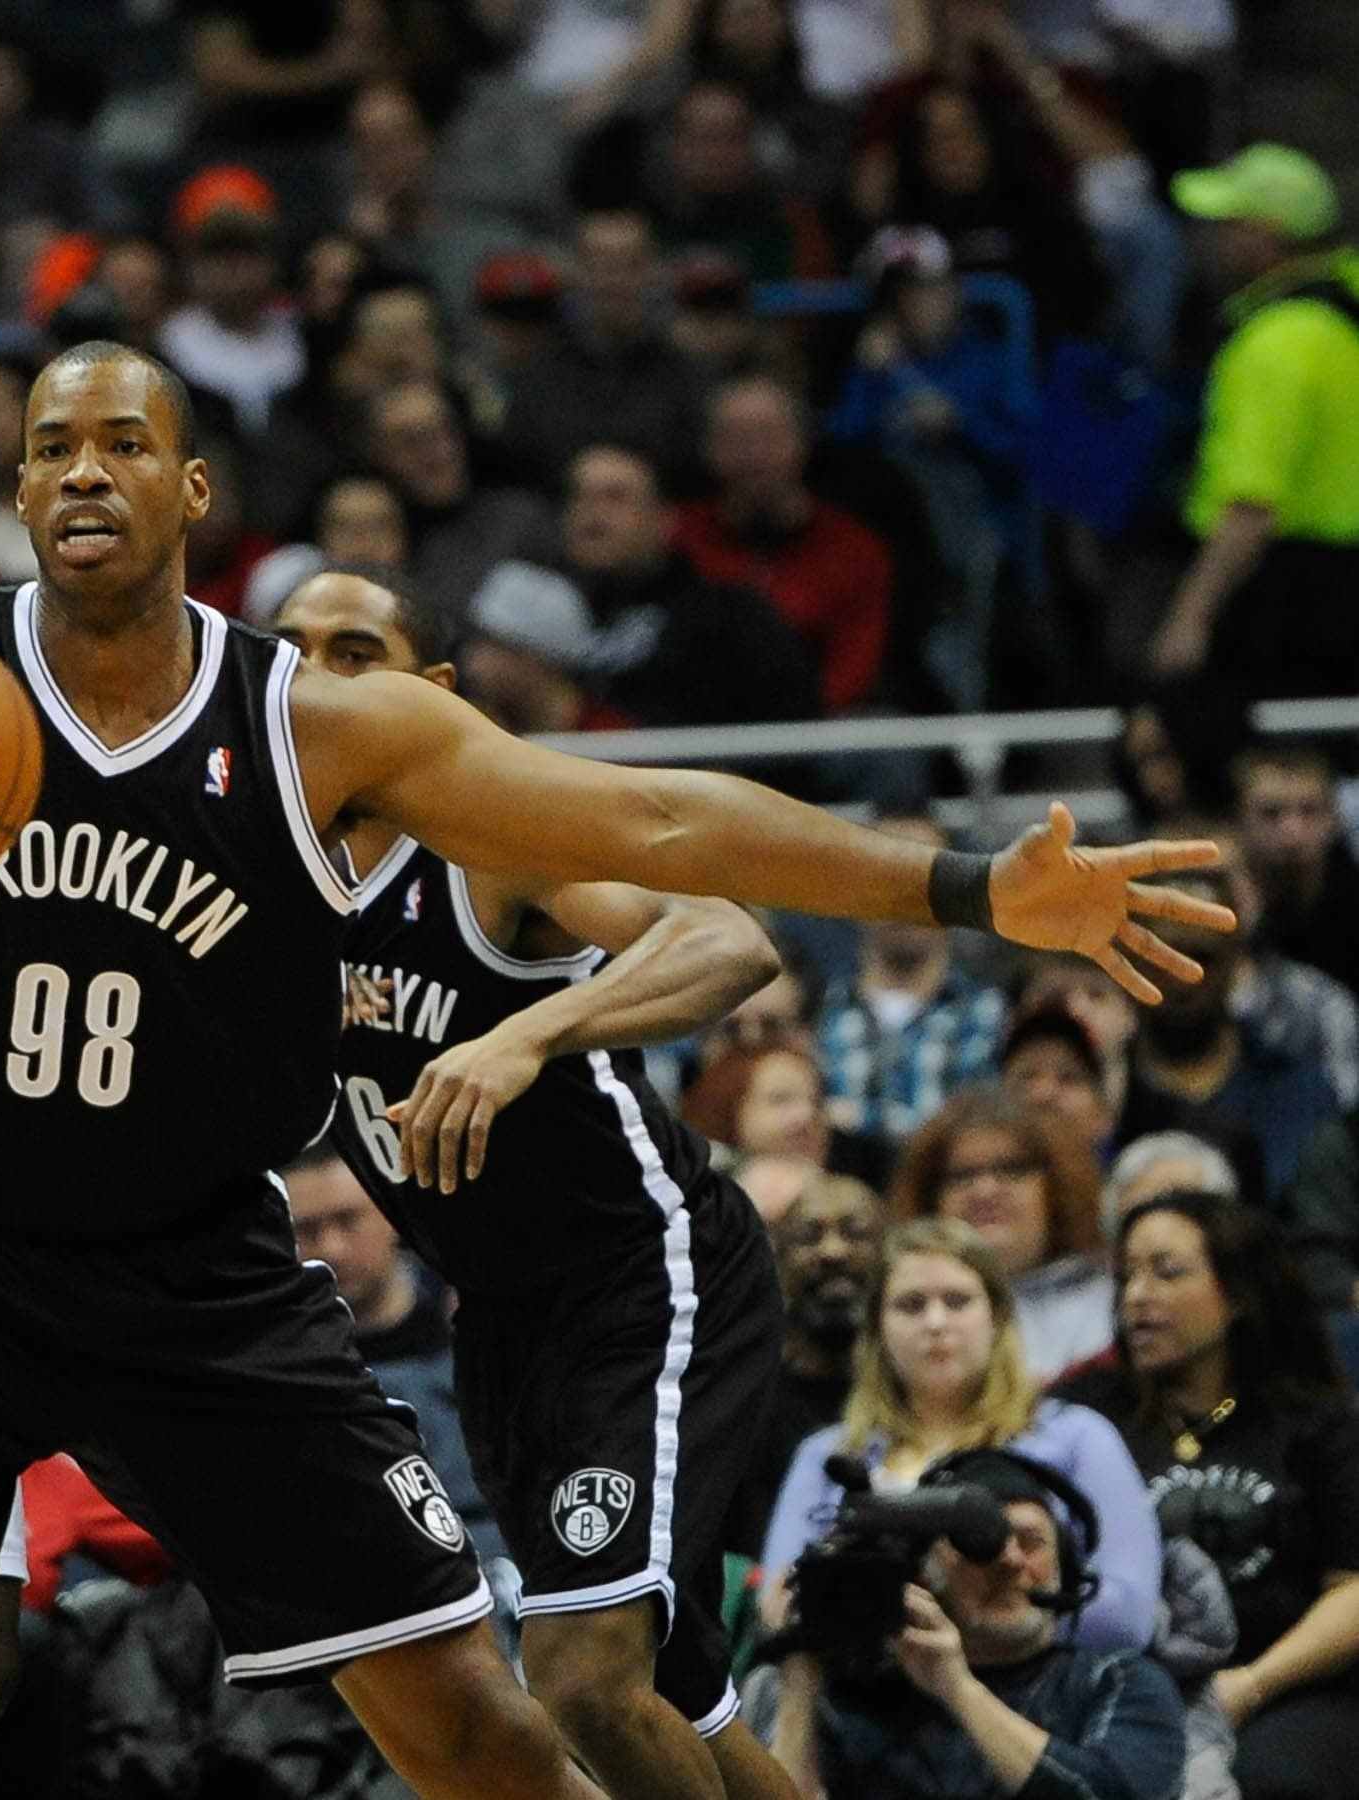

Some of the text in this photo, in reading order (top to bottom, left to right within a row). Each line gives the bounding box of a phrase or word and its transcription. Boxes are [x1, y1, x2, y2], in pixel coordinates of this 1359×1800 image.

[5, 961, 142, 1108] 98
[345, 1075, 410, 1184] 6
[554, 1472, 628, 1514] NETS
[580, 1512, 594, 1542] B
